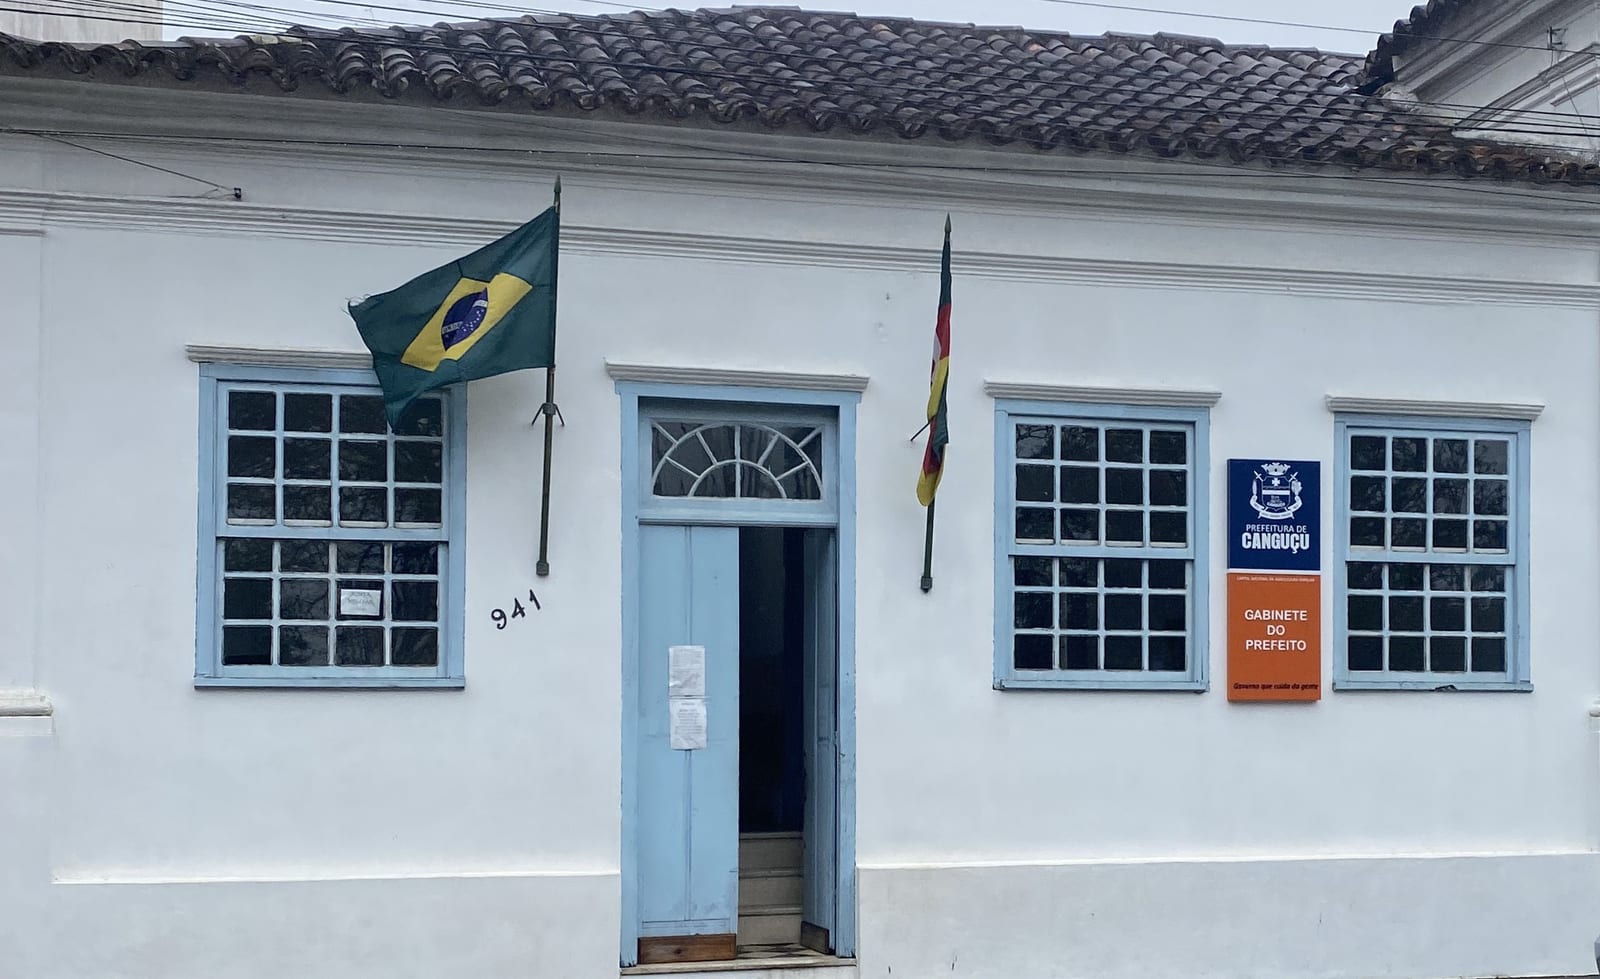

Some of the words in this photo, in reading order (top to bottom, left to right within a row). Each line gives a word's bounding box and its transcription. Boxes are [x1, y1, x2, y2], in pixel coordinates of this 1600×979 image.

[1246, 524, 1295, 533] PREFEITURA
[1296, 525, 1308, 533] DE
[1241, 532, 1310, 554] CANGUÇU
[491, 589, 541, 630] 941
[1244, 609, 1308, 621] GABINETE
[1266, 624, 1286, 636] DO
[1245, 639, 1307, 651] PREFEITO
